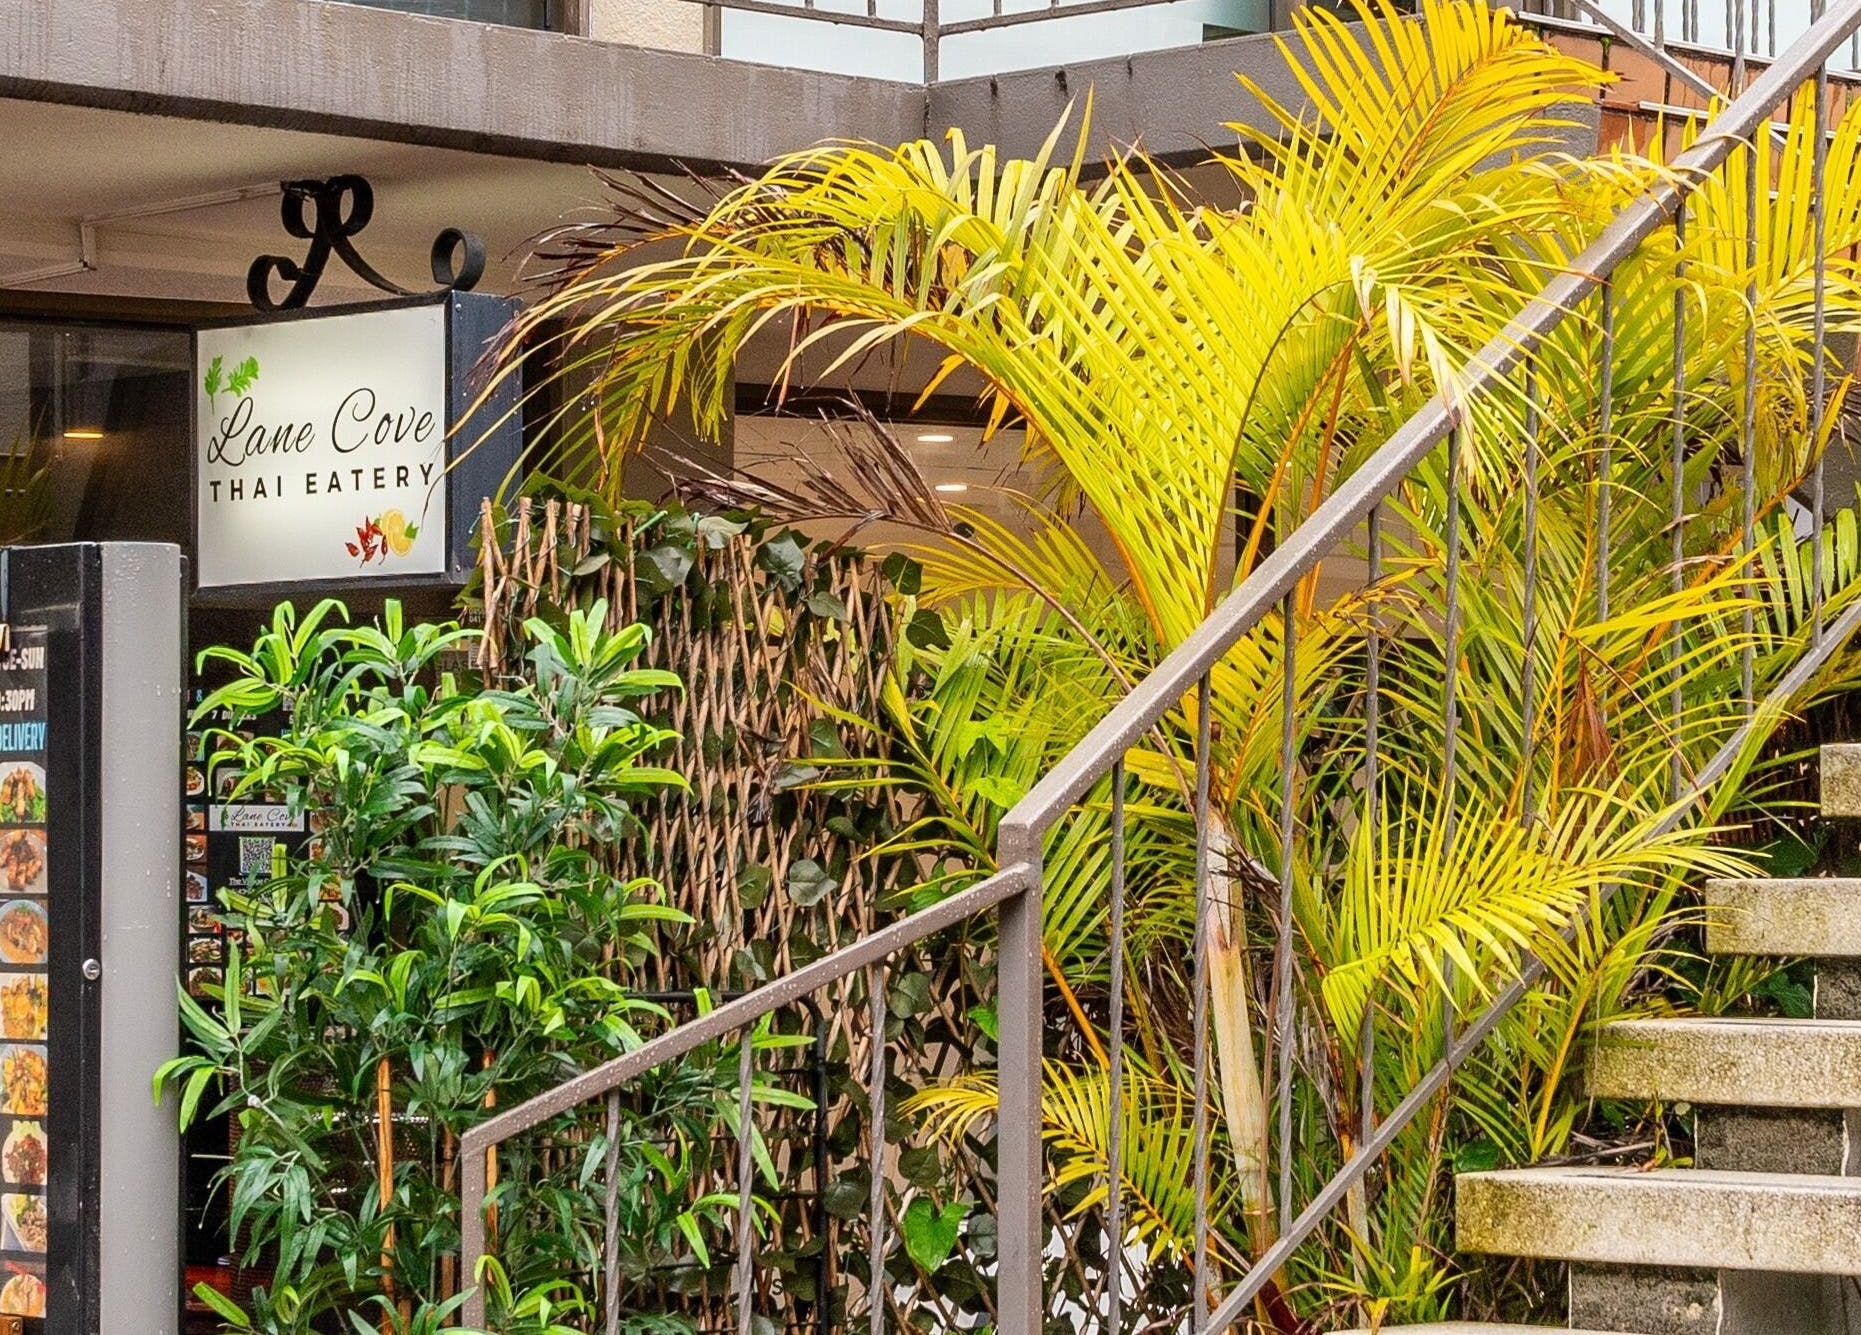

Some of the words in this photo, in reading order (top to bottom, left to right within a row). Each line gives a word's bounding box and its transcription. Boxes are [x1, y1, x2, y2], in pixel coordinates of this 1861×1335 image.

[207, 396, 316, 467] Lane
[331, 387, 436, 454] Cove
[209, 475, 283, 503] THAI
[305, 463, 435, 496] EATERY
[0, 688, 36, 712] :30PM
[266, 807, 290, 823] Cov
